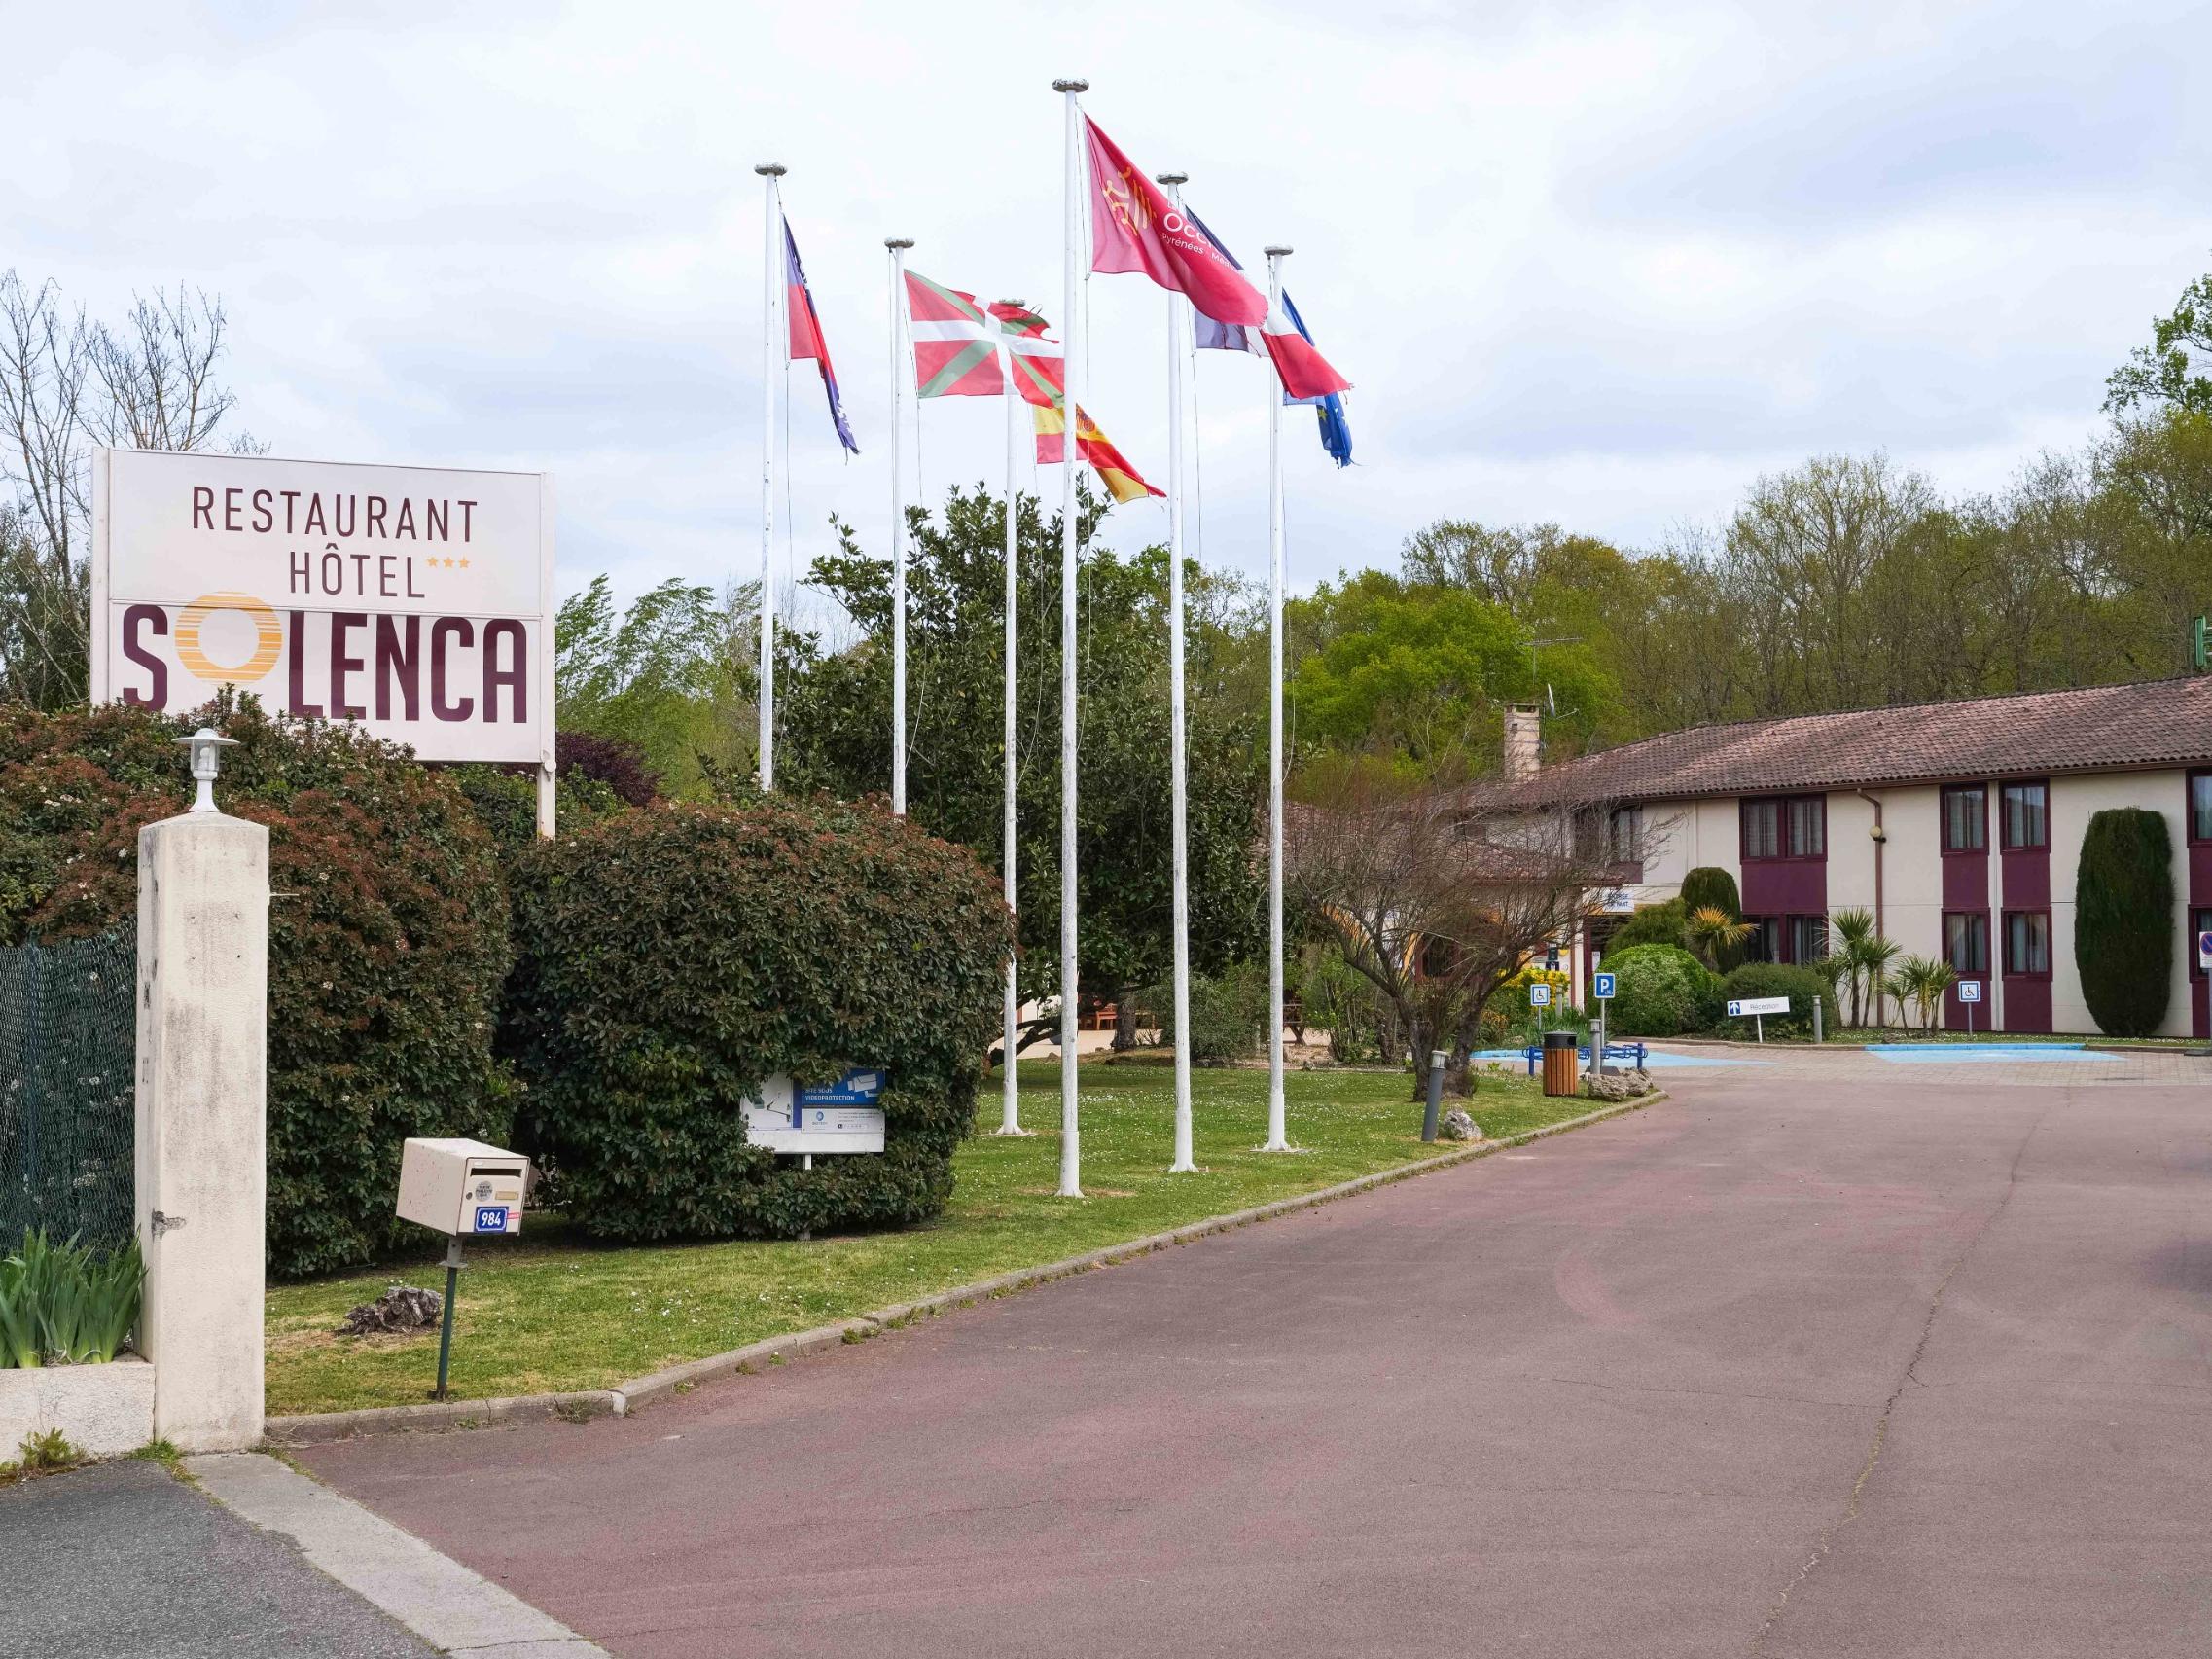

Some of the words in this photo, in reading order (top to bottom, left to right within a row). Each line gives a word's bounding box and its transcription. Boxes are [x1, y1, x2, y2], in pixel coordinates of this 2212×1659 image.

[192, 486, 479, 543] RESTAURANT
[290, 542, 426, 599] HÔTEL
[123, 591, 528, 724] SOLENCA
[1600, 978, 1610, 993] P
[482, 1211, 501, 1226] 984
